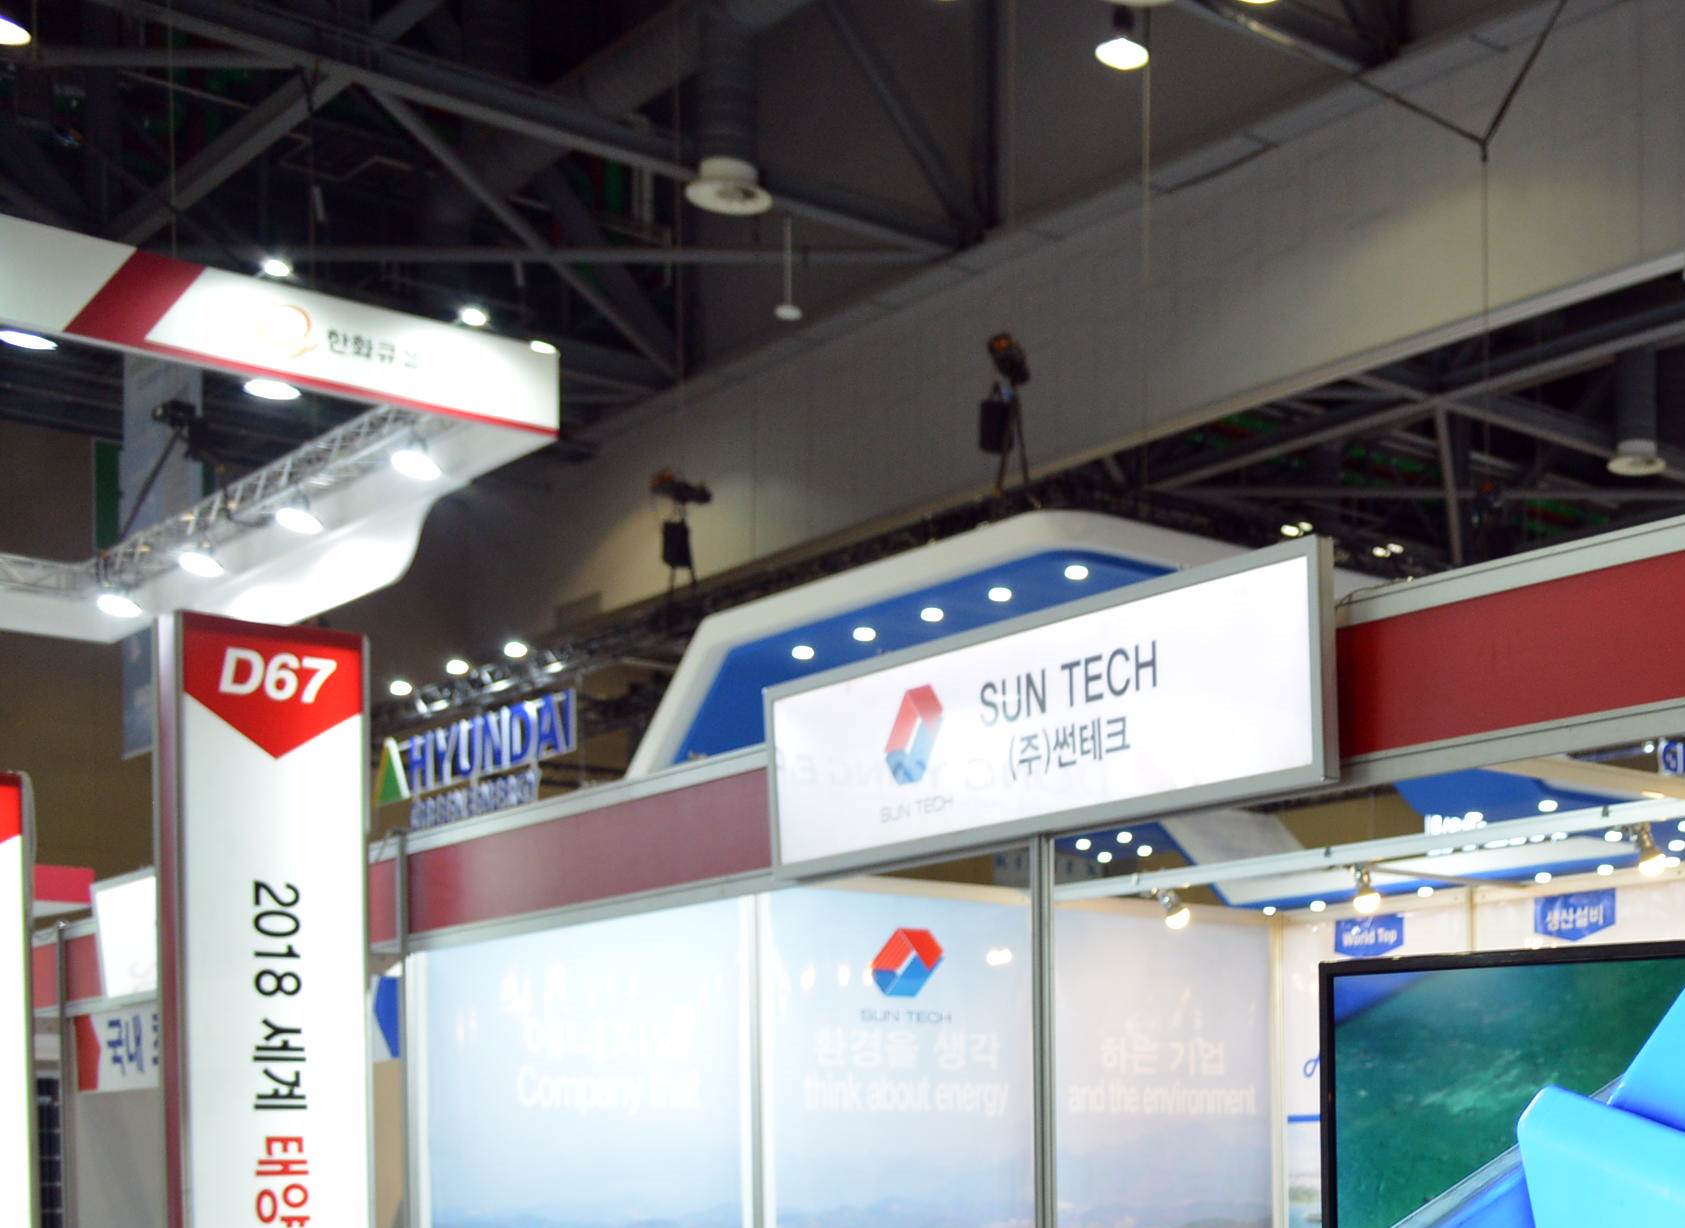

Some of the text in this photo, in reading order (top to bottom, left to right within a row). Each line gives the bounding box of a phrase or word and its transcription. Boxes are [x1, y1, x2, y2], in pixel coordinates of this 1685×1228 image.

[219, 647, 337, 705] D67
[980, 640, 1158, 727] SUN TECH
[409, 688, 577, 796] HYUNDAI
[1008, 715, 1131, 781] (주)썬테크
[880, 795, 954, 824] SUN TECH
[251, 879, 302, 997] 2018
[1341, 927, 1398, 948] World Top
[860, 1008, 953, 1026] SUN TECH
[252, 1017, 309, 1111] 세계
[935, 1030, 1002, 1072] 생각
[1100, 1037, 1227, 1076] 하는 기업
[802, 1073, 1009, 1119] think about energy
[1069, 1081, 1256, 1116] and the environment
